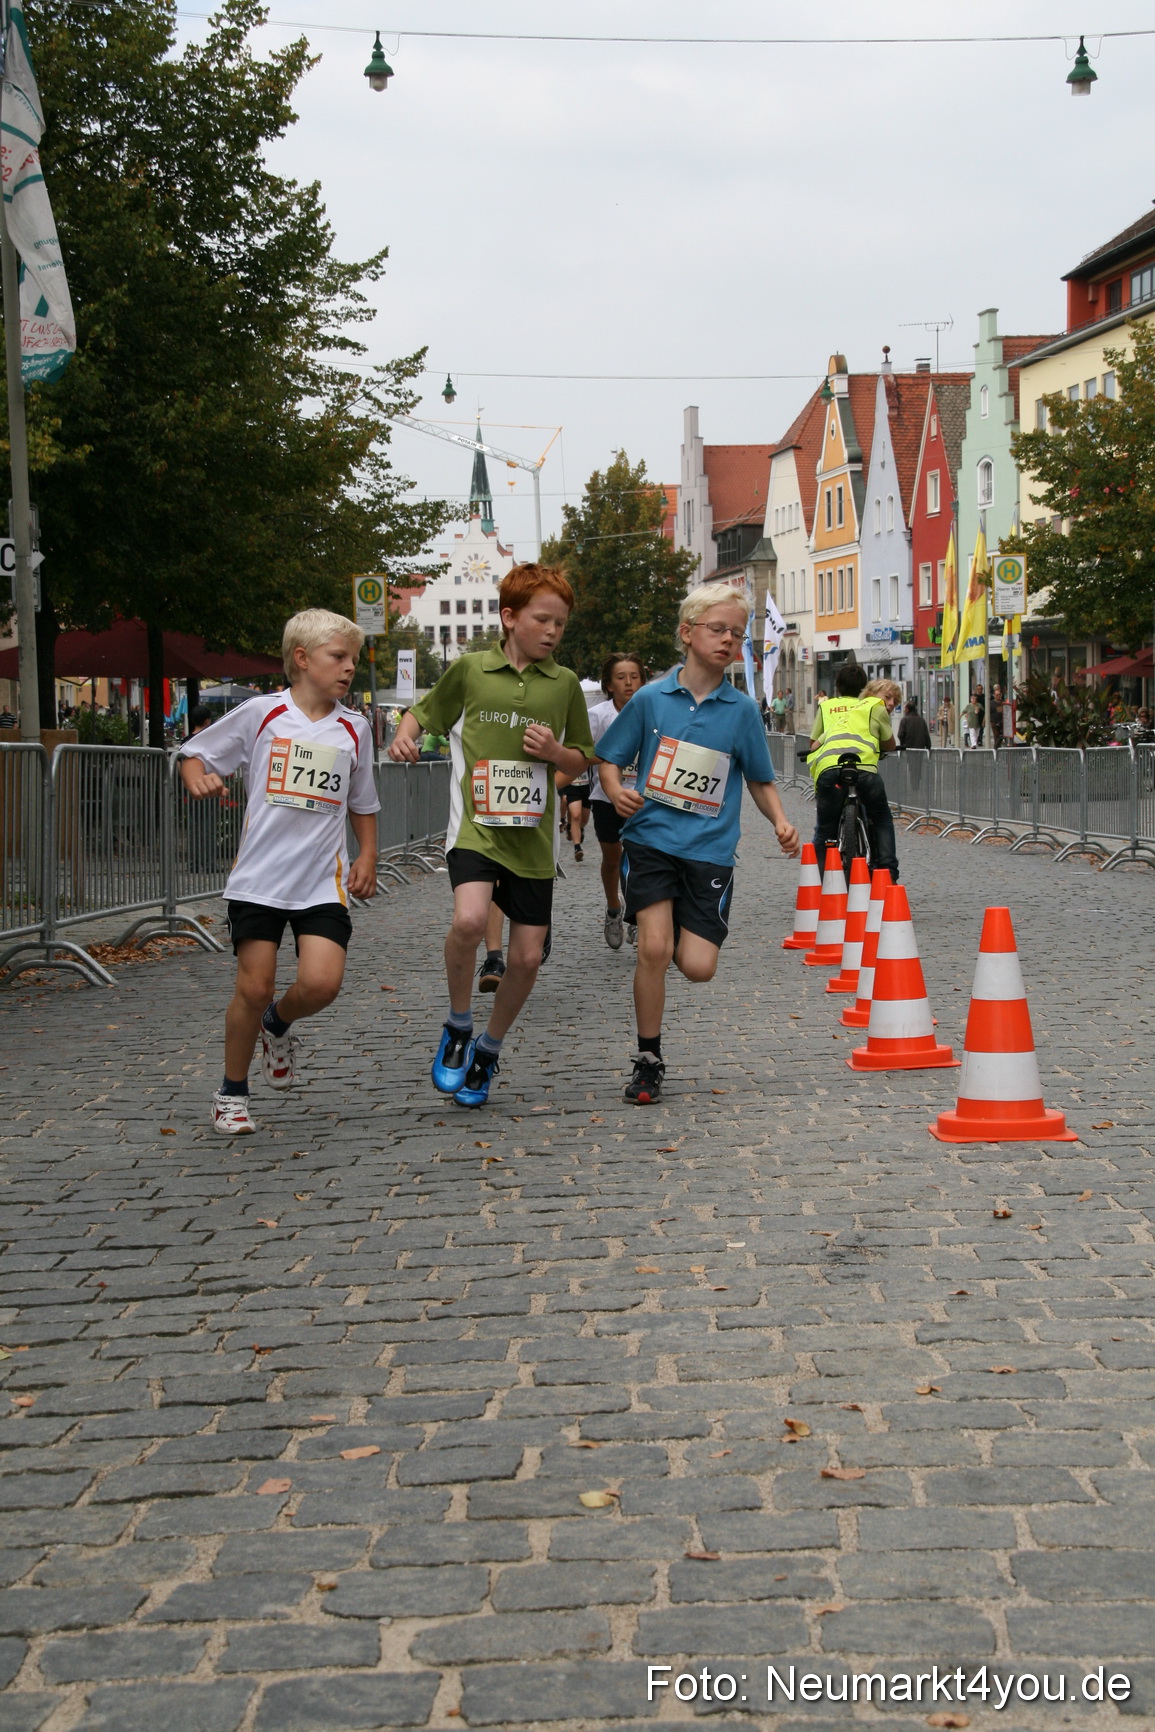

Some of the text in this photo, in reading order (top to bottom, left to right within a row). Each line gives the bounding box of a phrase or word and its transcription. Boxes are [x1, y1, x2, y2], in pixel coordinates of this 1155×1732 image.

[479, 710, 509, 724] EURO
[294, 744, 313, 760] Tim
[272, 761, 282, 773] K6
[493, 764, 534, 780] Frederik
[292, 765, 342, 793] 7123
[672, 767, 721, 795] 7237
[474, 784, 485, 795] K6
[494, 785, 542, 806] 7024
